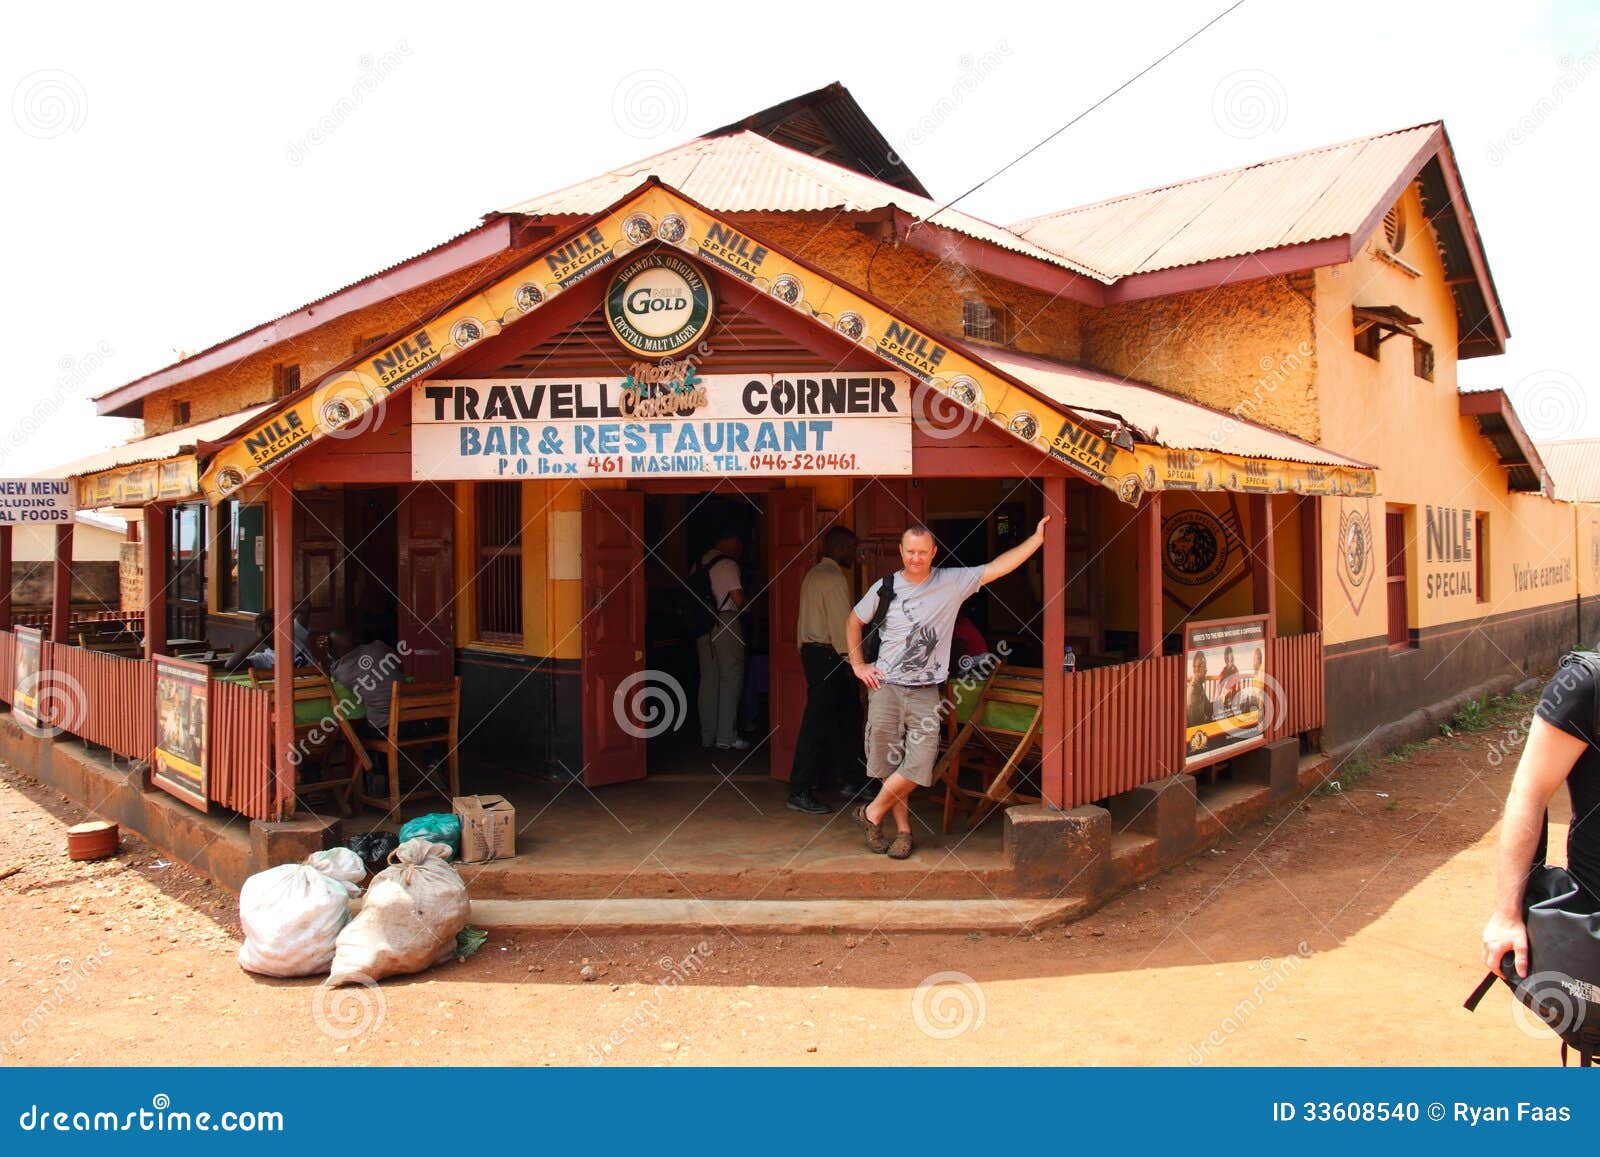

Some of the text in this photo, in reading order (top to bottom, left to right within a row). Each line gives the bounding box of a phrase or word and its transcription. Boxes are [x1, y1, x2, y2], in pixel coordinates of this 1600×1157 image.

[544, 226, 604, 272] NILE
[554, 243, 609, 280] SPECIAL
[702, 239, 759, 274] SPECIAL
[706, 223, 768, 266] NILE
[619, 255, 702, 291] UGANDA'S ORIGINAL
[613, 315, 698, 350] CRYSTAL MALT LAGER
[885, 320, 947, 366] NILE
[372, 329, 432, 376] NILE
[382, 347, 436, 384] SPECIAL
[880, 337, 935, 374] SPECIAL
[425, 377, 898, 421] TRAVELL CORNER
[243, 410, 302, 456] NILE
[254, 427, 308, 464] SPECIAL
[460, 420, 832, 456] BAR & RESTAURANT
[1058, 420, 1119, 465] NILE
[587, 456, 624, 473] 461
[713, 454, 748, 472] TEL.
[1053, 437, 1108, 473] SPECIAL
[1167, 451, 1195, 470] NILE
[1244, 461, 1268, 476] NILE
[0, 482, 69, 495] NEW MENU
[1167, 470, 1195, 480] SPECIAL
[21, 510, 68, 520] FOODS
[1426, 505, 1472, 562] NILE
[1426, 571, 1472, 598] SPECIAL
